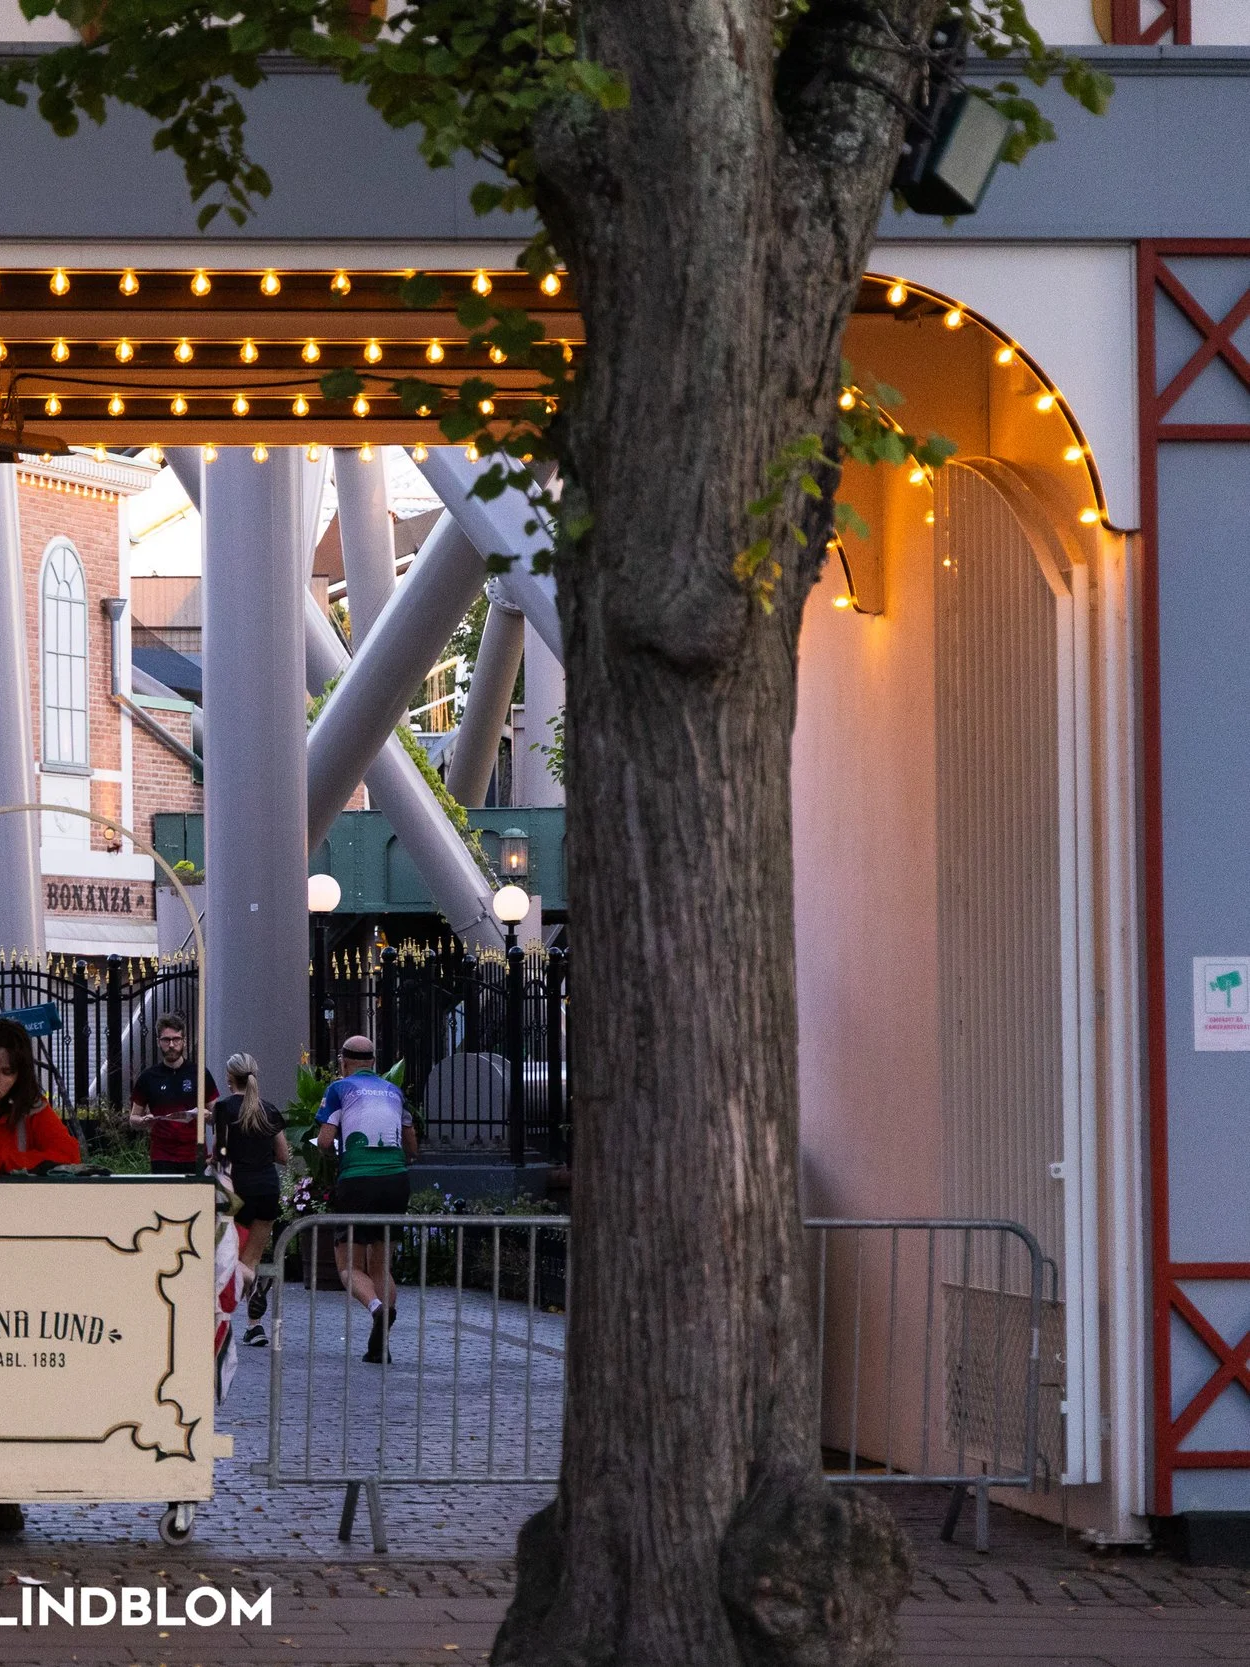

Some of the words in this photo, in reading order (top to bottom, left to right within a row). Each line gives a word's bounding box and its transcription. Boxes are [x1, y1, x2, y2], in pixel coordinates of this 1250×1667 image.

[47, 883, 132, 913] BONANZA
[39, 1310, 104, 1345] LUND
[33, 1352, 66, 1368] 1883
